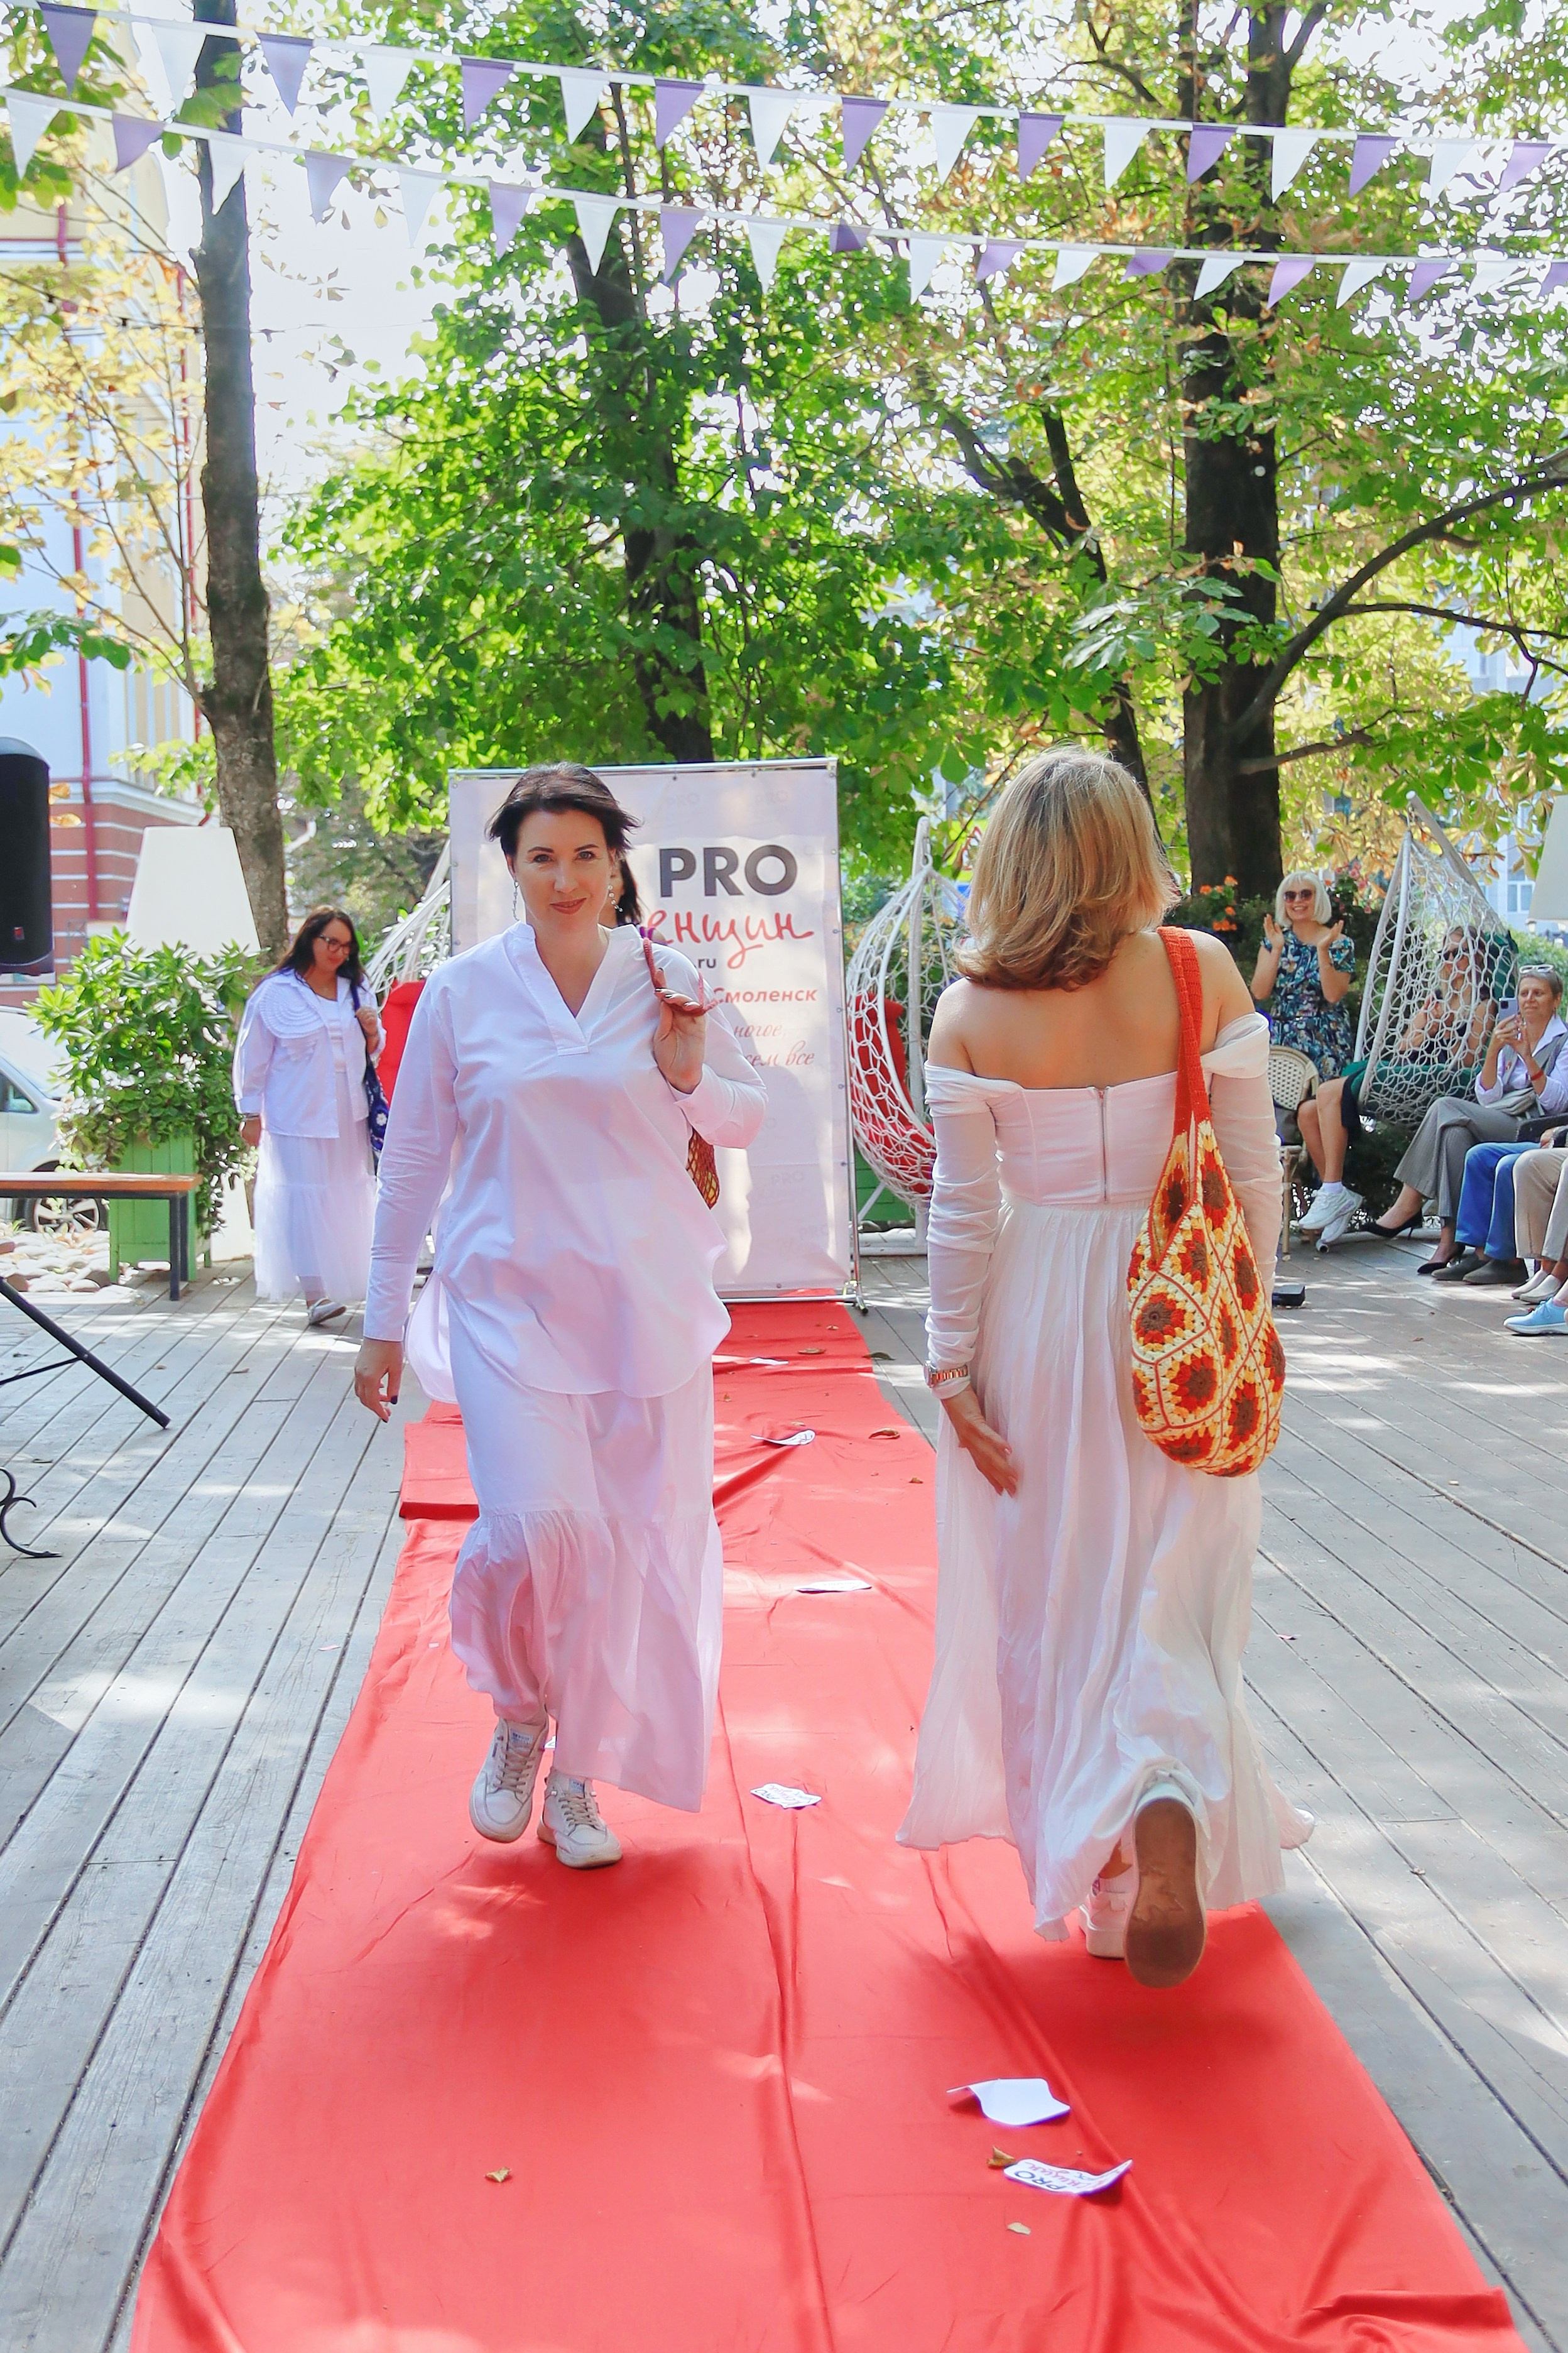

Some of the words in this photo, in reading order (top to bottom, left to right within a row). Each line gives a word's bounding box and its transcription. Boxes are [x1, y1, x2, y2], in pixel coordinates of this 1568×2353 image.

[659, 844, 798, 897] PRO
[646, 910, 815, 969] енщин
[697, 958, 717, 969] ru
[713, 987, 818, 1003] Смоленск
[734, 1024, 786, 1040] ногое,
[744, 1052, 779, 1067] сем
[1014, 2170, 1067, 2190] PRO
